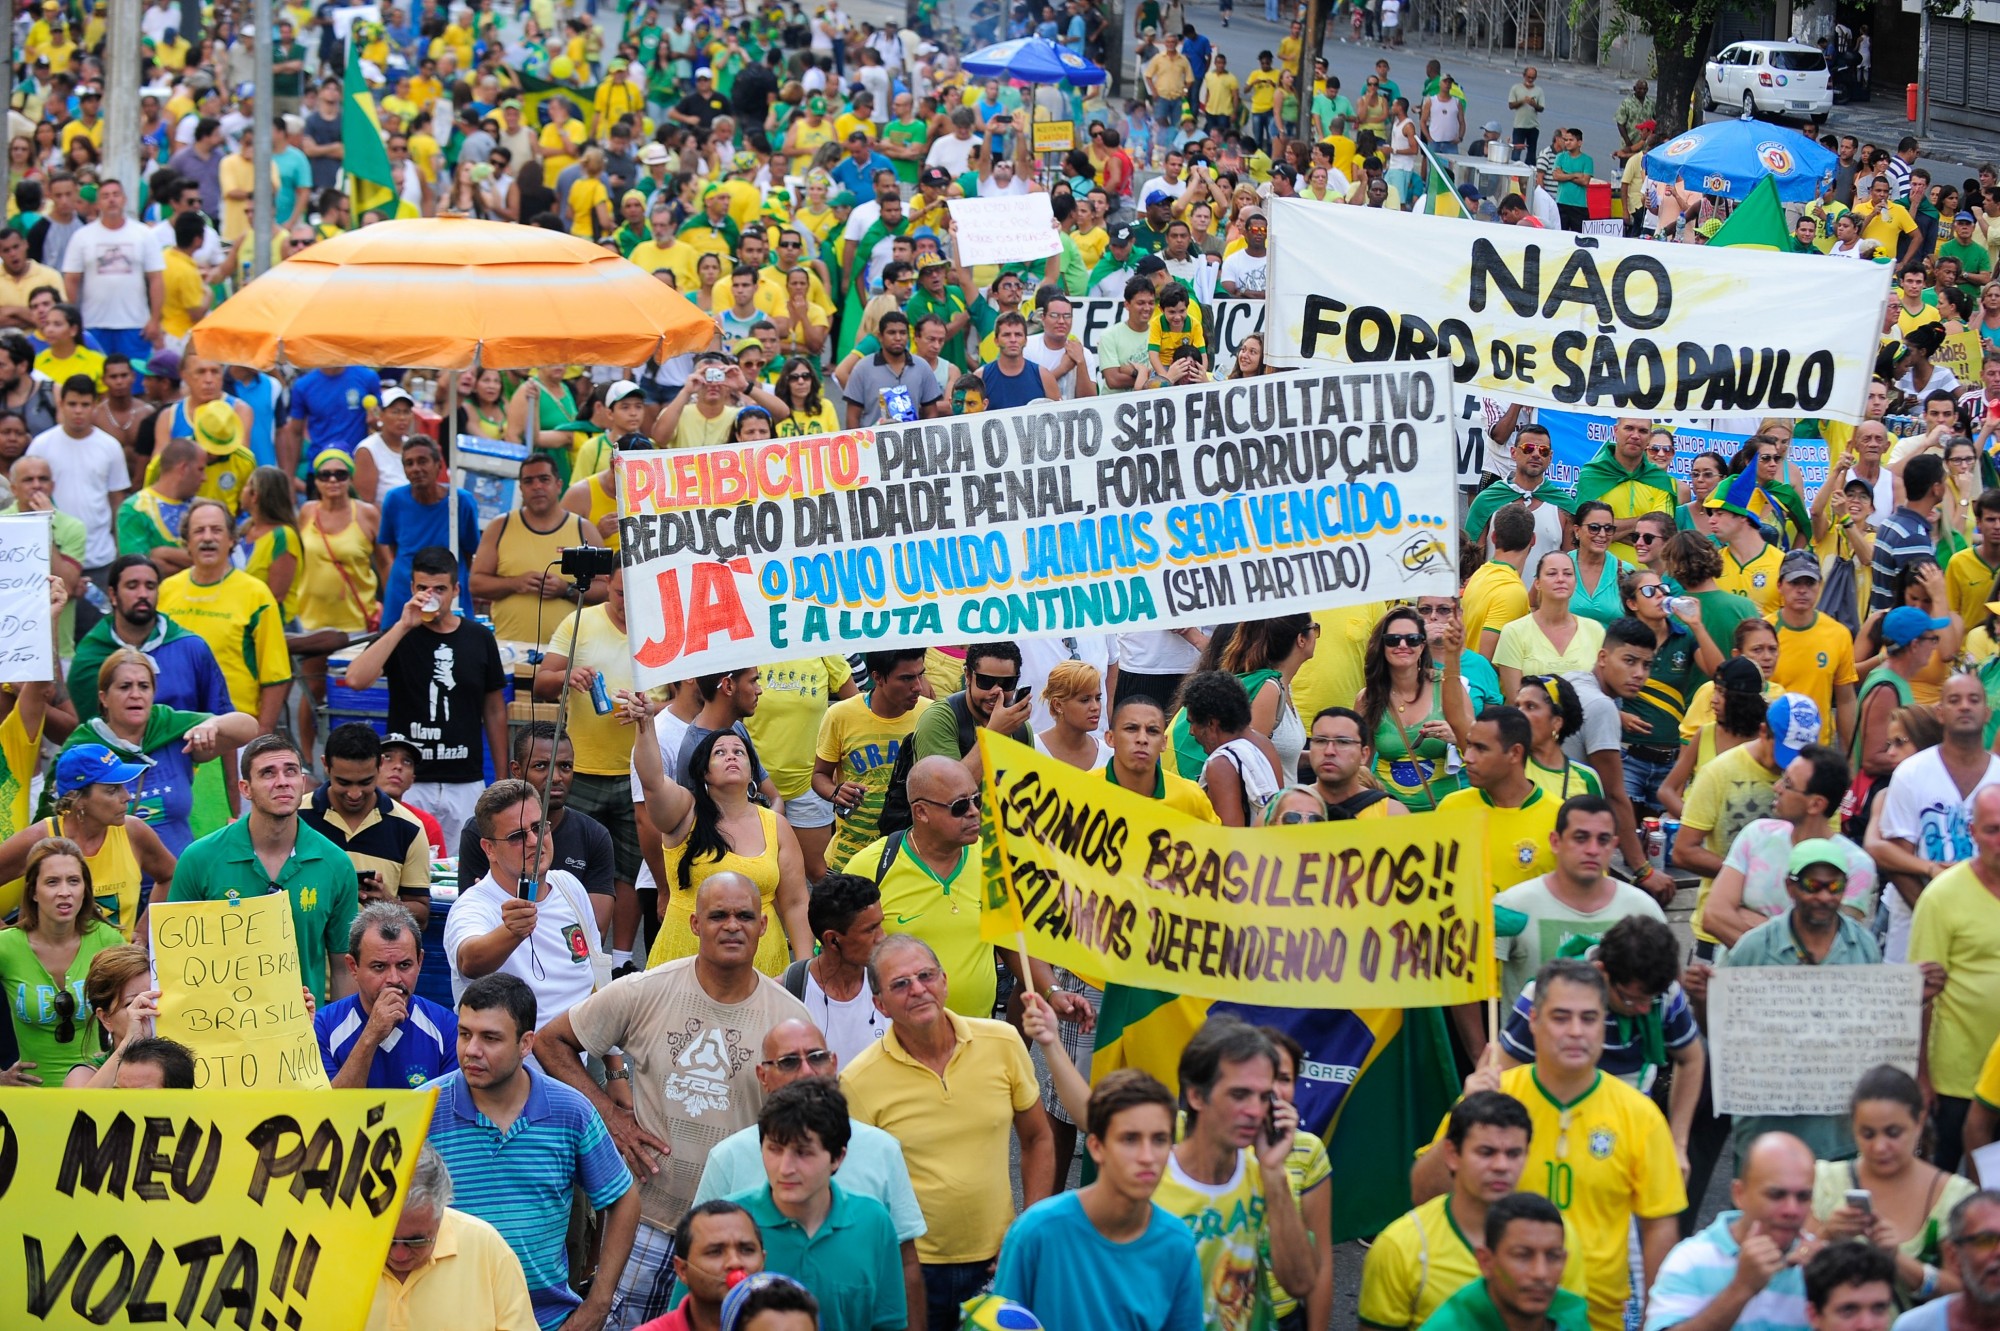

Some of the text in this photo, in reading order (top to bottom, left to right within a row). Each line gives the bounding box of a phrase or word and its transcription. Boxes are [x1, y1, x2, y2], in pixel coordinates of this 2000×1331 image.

[1583, 221, 1622, 236] Military
[1468, 236, 1673, 330] NÃO
[1301, 294, 1480, 384] FORO
[1491, 339, 1536, 385] DE
[1552, 324, 1668, 411] SÃO
[1674, 340, 1833, 413] PAULO
[876, 419, 963, 481] PARA
[982, 416, 1008, 470] O
[1011, 407, 1101, 465] VOTO
[1111, 398, 1176, 452] SER
[1186, 371, 1446, 443] FACULTATIVO,
[1587, 422, 1608, 442] SEM
[1706, 438, 1741, 457] JANOT
[1787, 445, 1818, 462] ADOR
[619, 500, 783, 568] REDUÇÃO
[794, 491, 843, 547] DA
[847, 477, 956, 542] IDADE
[962, 465, 1097, 529] PENAL,
[1097, 448, 1184, 510] FORA
[1194, 420, 1418, 495] CORRUPÇÃO
[758, 560, 788, 601] O
[890, 529, 1013, 604] UNIDO
[1019, 510, 1161, 588] JAMAIS
[1166, 492, 1250, 566] SERÁ
[634, 556, 756, 668] JÁ
[801, 605, 830, 643] A
[839, 602, 943, 640] LUTA
[957, 575, 1157, 635] CONTINUA
[1163, 556, 1244, 618] (SEM
[1244, 542, 1370, 601] PARTIDO)
[1816, 651, 1828, 668] 9
[410, 721, 442, 740] Olavo
[437, 743, 469, 760] Razão
[849, 739, 901, 775] BRA
[94, 881, 127, 894] aneiro
[1142, 828, 1460, 907] BRASILEIROS!!
[159, 910, 265, 949] GOLPE
[1010, 856, 1479, 985] STAMOS DEFENDENDO O PAÍS!
[183, 946, 299, 987] QUEBRA
[232, 985, 252, 1003] O
[193, 1032, 320, 1089] OTO NÃO
[1299, 1062, 1359, 1082] OGRES
[56, 1108, 223, 1205] MEU
[245, 1101, 403, 1219] PAÍS
[1544, 1160, 1572, 1210] 10
[1182, 1196, 1265, 1243] BRAS
[22, 1228, 322, 1331] VOLTA!!
